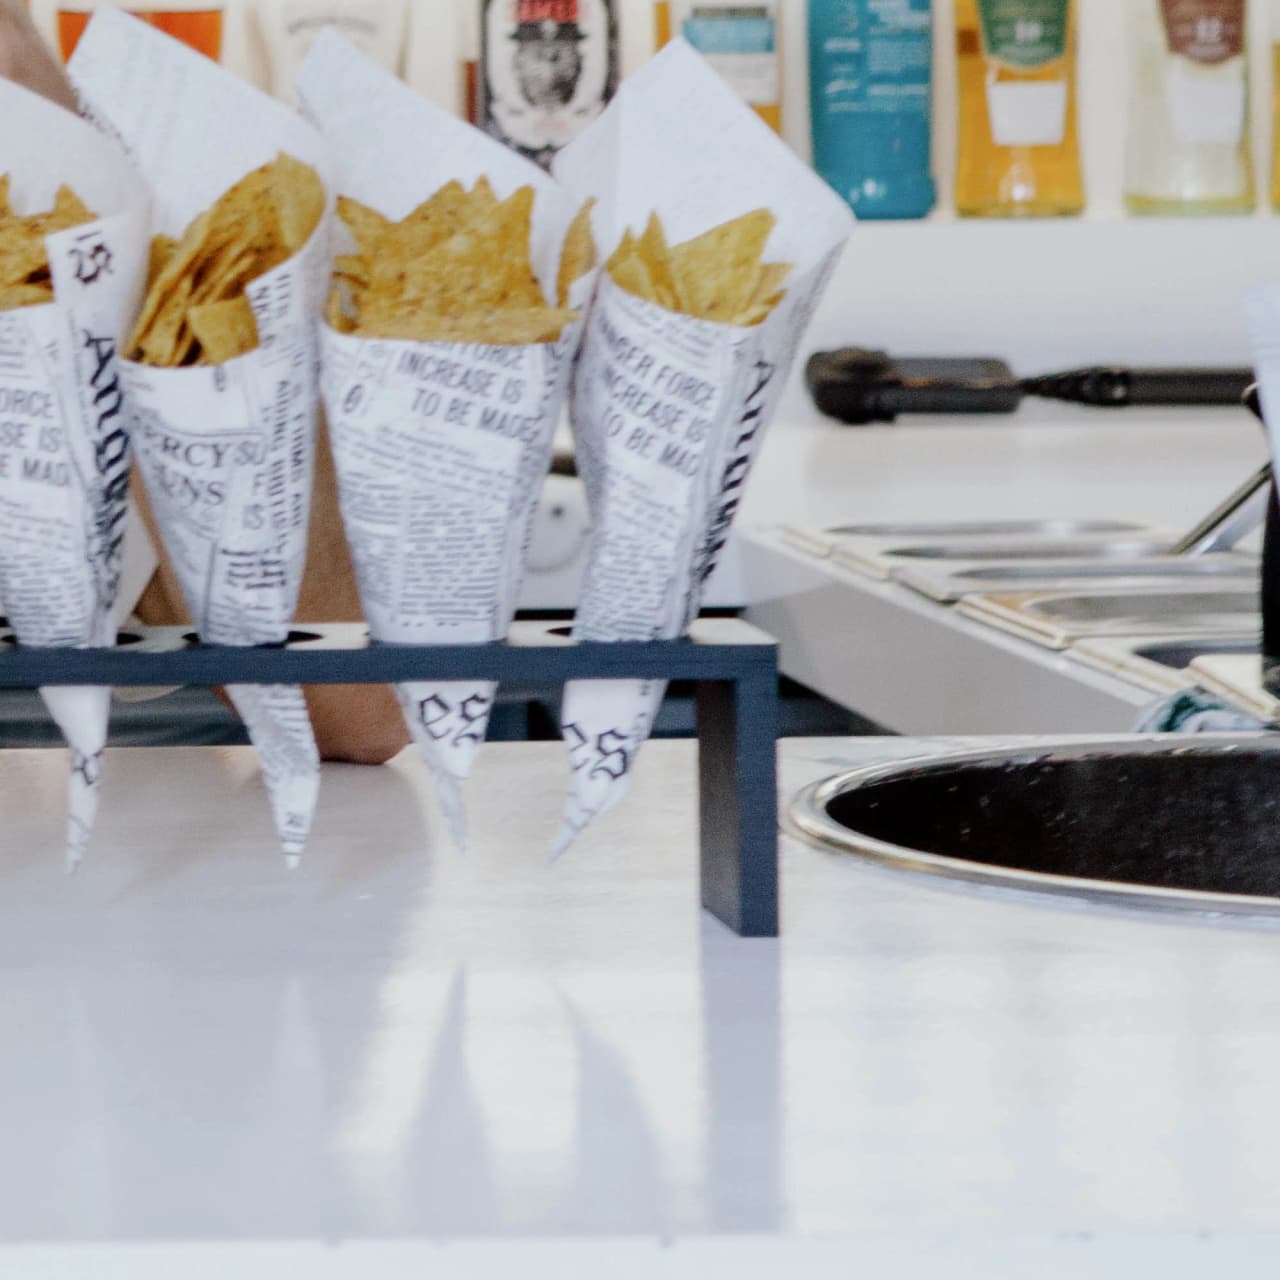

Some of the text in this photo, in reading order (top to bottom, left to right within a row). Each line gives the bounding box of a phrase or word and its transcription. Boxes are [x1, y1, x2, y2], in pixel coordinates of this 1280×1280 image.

[396, 348, 527, 406] INCREASE IS
[653, 364, 717, 412] FORCE
[411, 386, 443, 417] TO
[443, 396, 474, 427] BE
[38, 426, 64, 454] IS
[625, 426, 658, 459] BE
[658, 440, 700, 478] MAD
[22, 456, 71, 488] MAD
